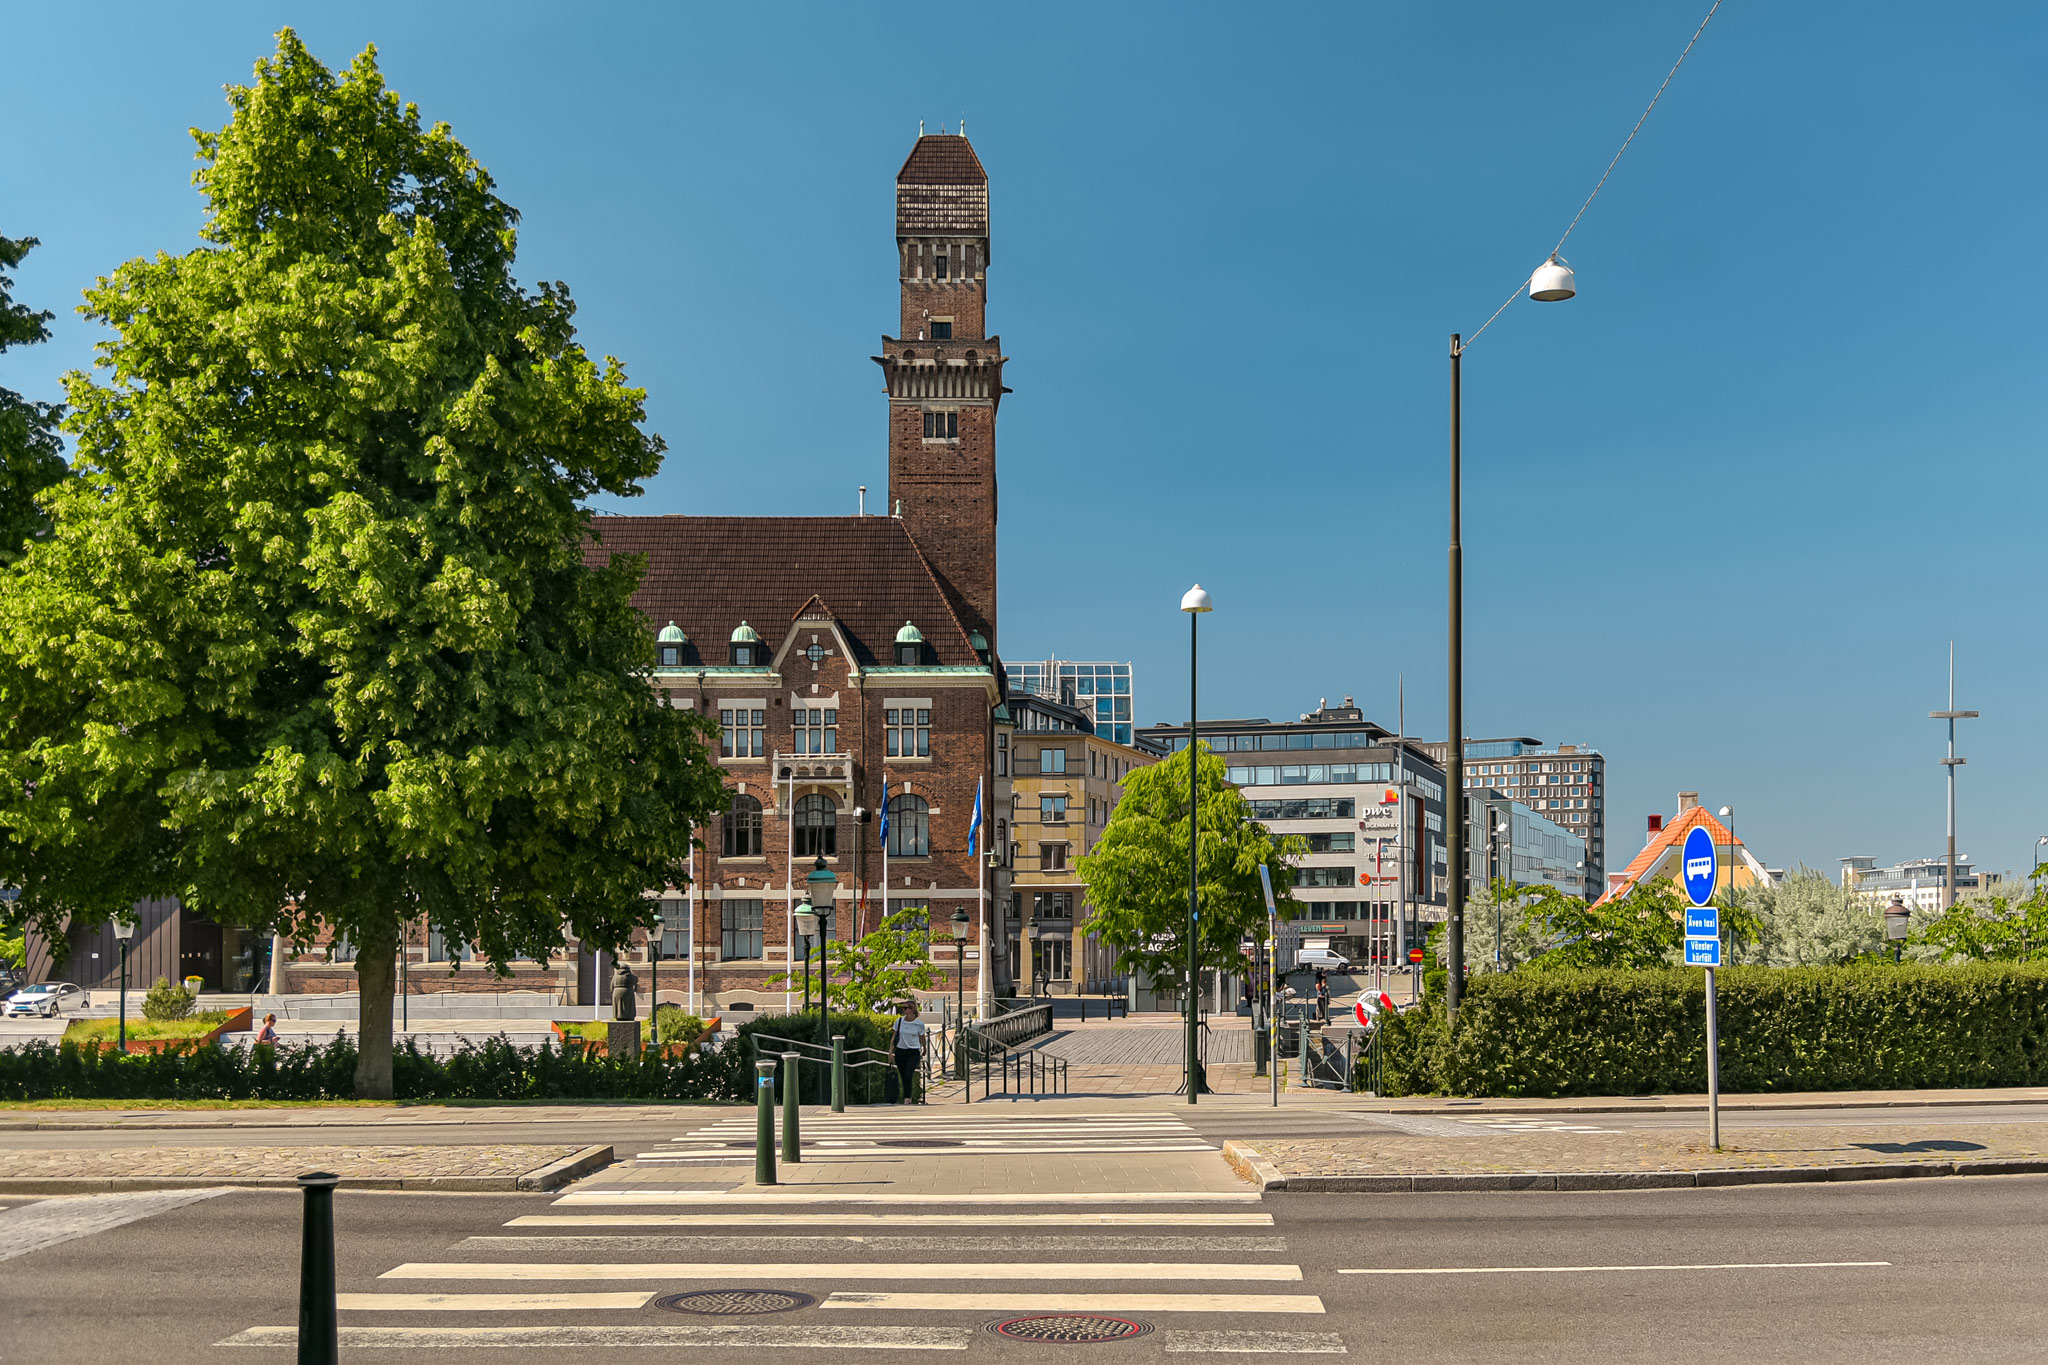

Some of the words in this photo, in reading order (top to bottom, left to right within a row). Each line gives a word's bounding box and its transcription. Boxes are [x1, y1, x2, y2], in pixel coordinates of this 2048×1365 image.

[1362, 807, 1390, 818] pwc
[1688, 915, 1703, 927] Även
[1704, 918, 1715, 927] taxi
[1690, 941, 1713, 950] Vänster
[1691, 952, 1712, 963] körfält
